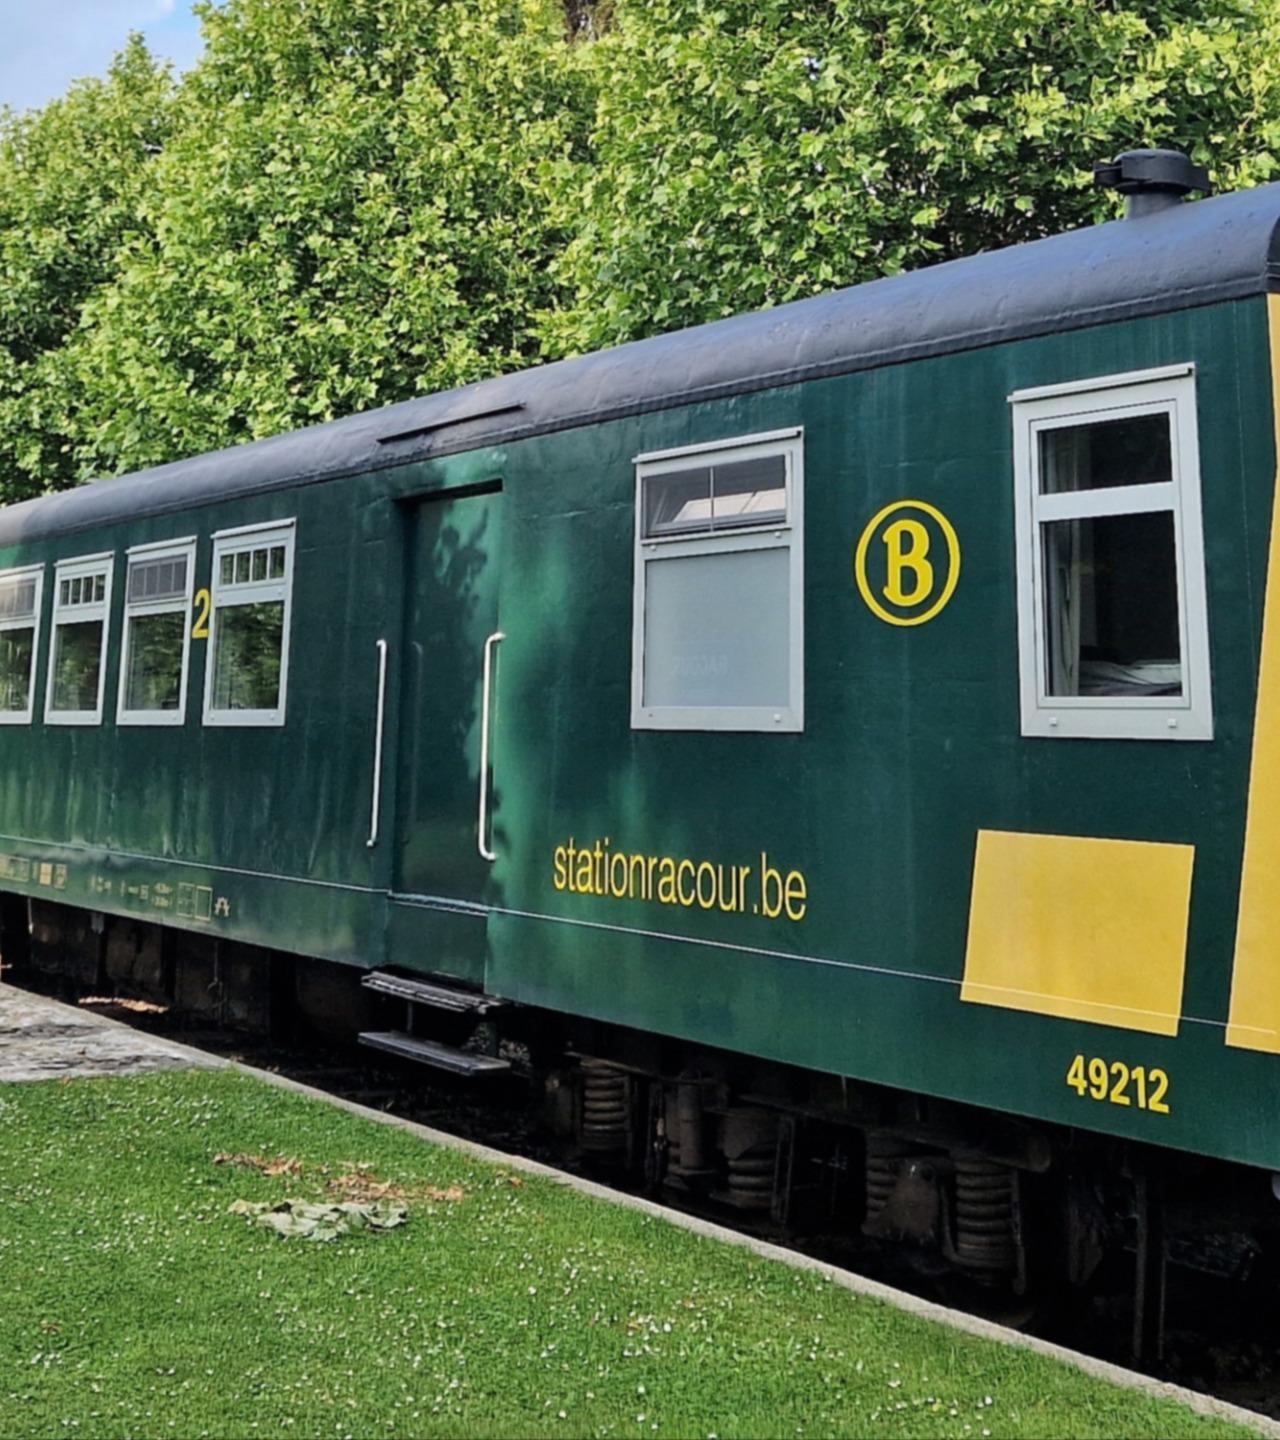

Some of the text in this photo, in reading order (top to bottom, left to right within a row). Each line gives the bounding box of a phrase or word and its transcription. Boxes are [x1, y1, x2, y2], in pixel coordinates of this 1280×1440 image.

[880, 517, 935, 608] B
[190, 587, 212, 639] 2
[553, 836, 807, 921] stationracour.be
[1066, 1053, 1171, 1114] 49212
